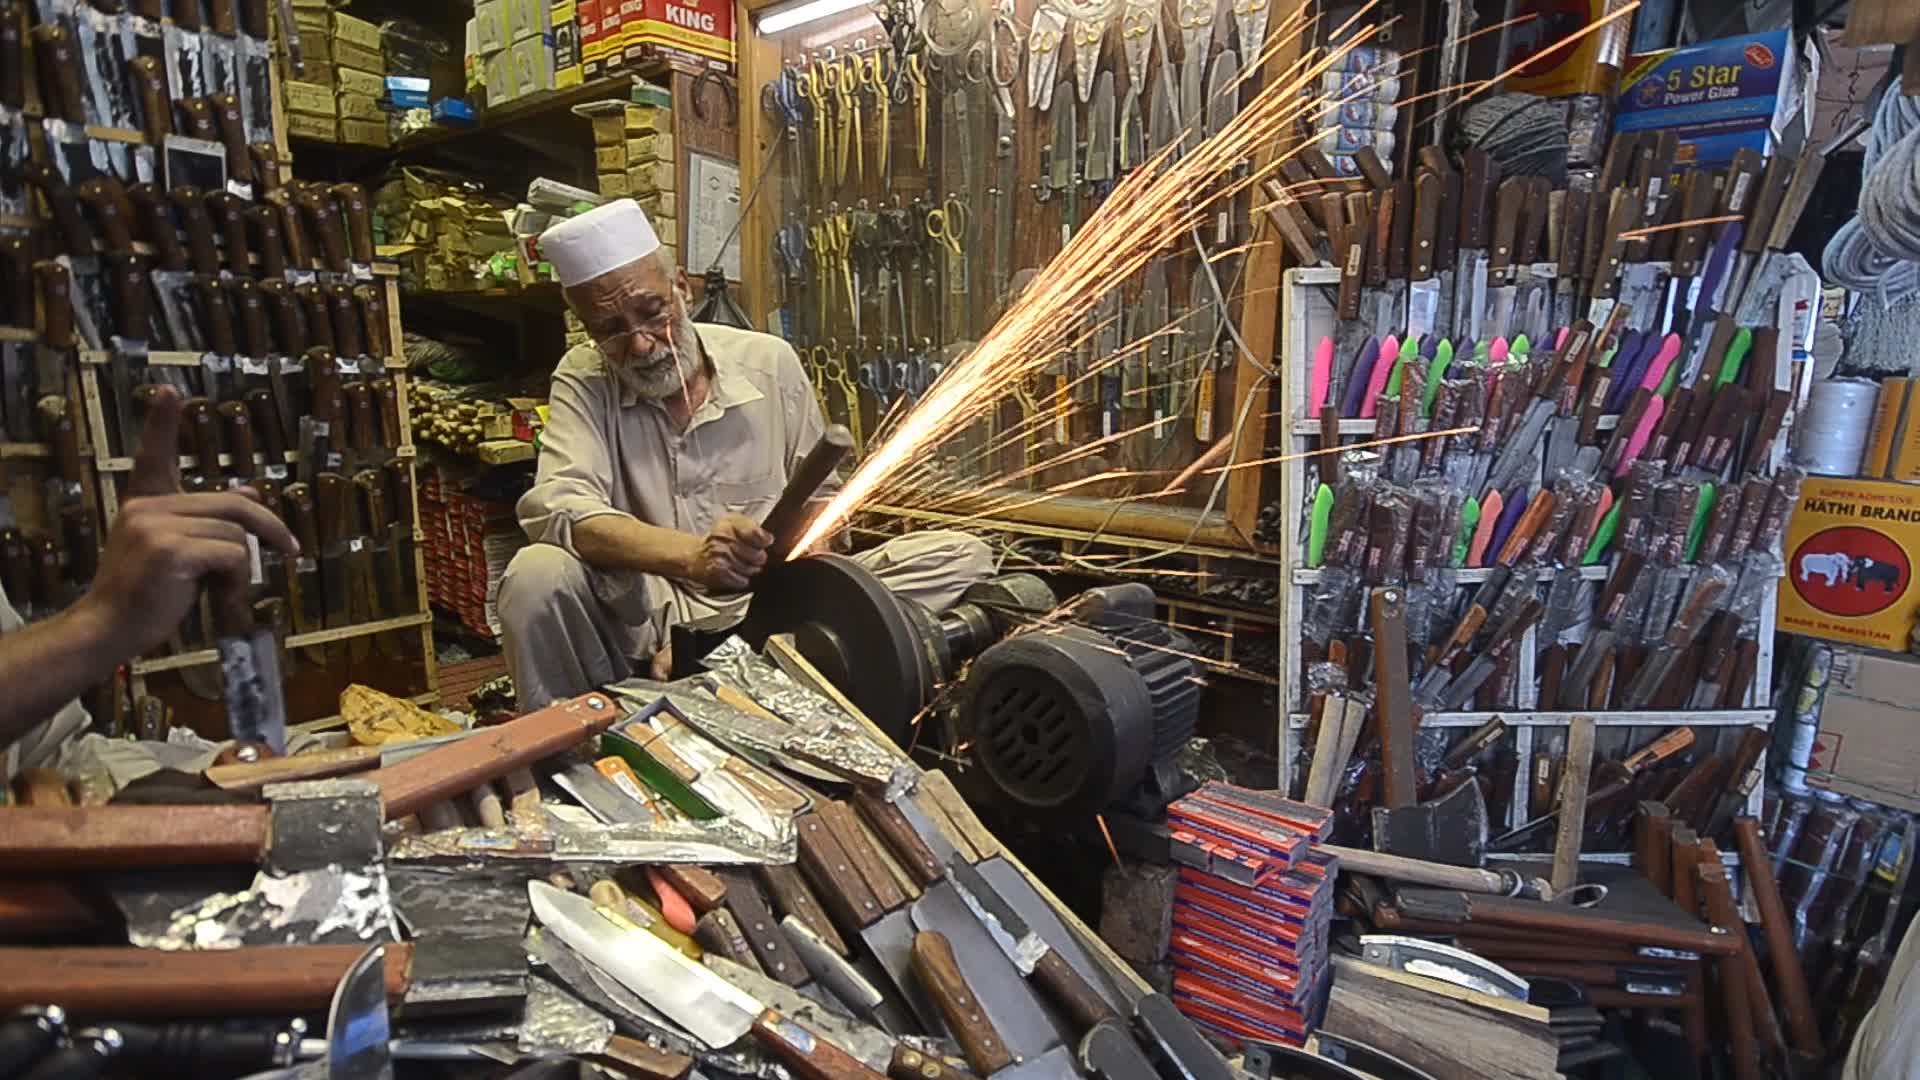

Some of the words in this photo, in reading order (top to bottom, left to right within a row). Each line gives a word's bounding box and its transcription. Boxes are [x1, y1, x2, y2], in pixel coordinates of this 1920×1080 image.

[665, 3, 715, 32] KING
[1666, 69, 1682, 92] 5
[1690, 64, 1743, 88] Star
[1663, 91, 1705, 105] Power
[1708, 86, 1740, 99] Glue
[1804, 498, 1856, 517] HATHI
[1860, 504, 1920, 523] BRAND
[1783, 616, 1814, 627] MADE
[1817, 621, 1830, 630] IN
[1831, 624, 1892, 640] PAKISTAN
